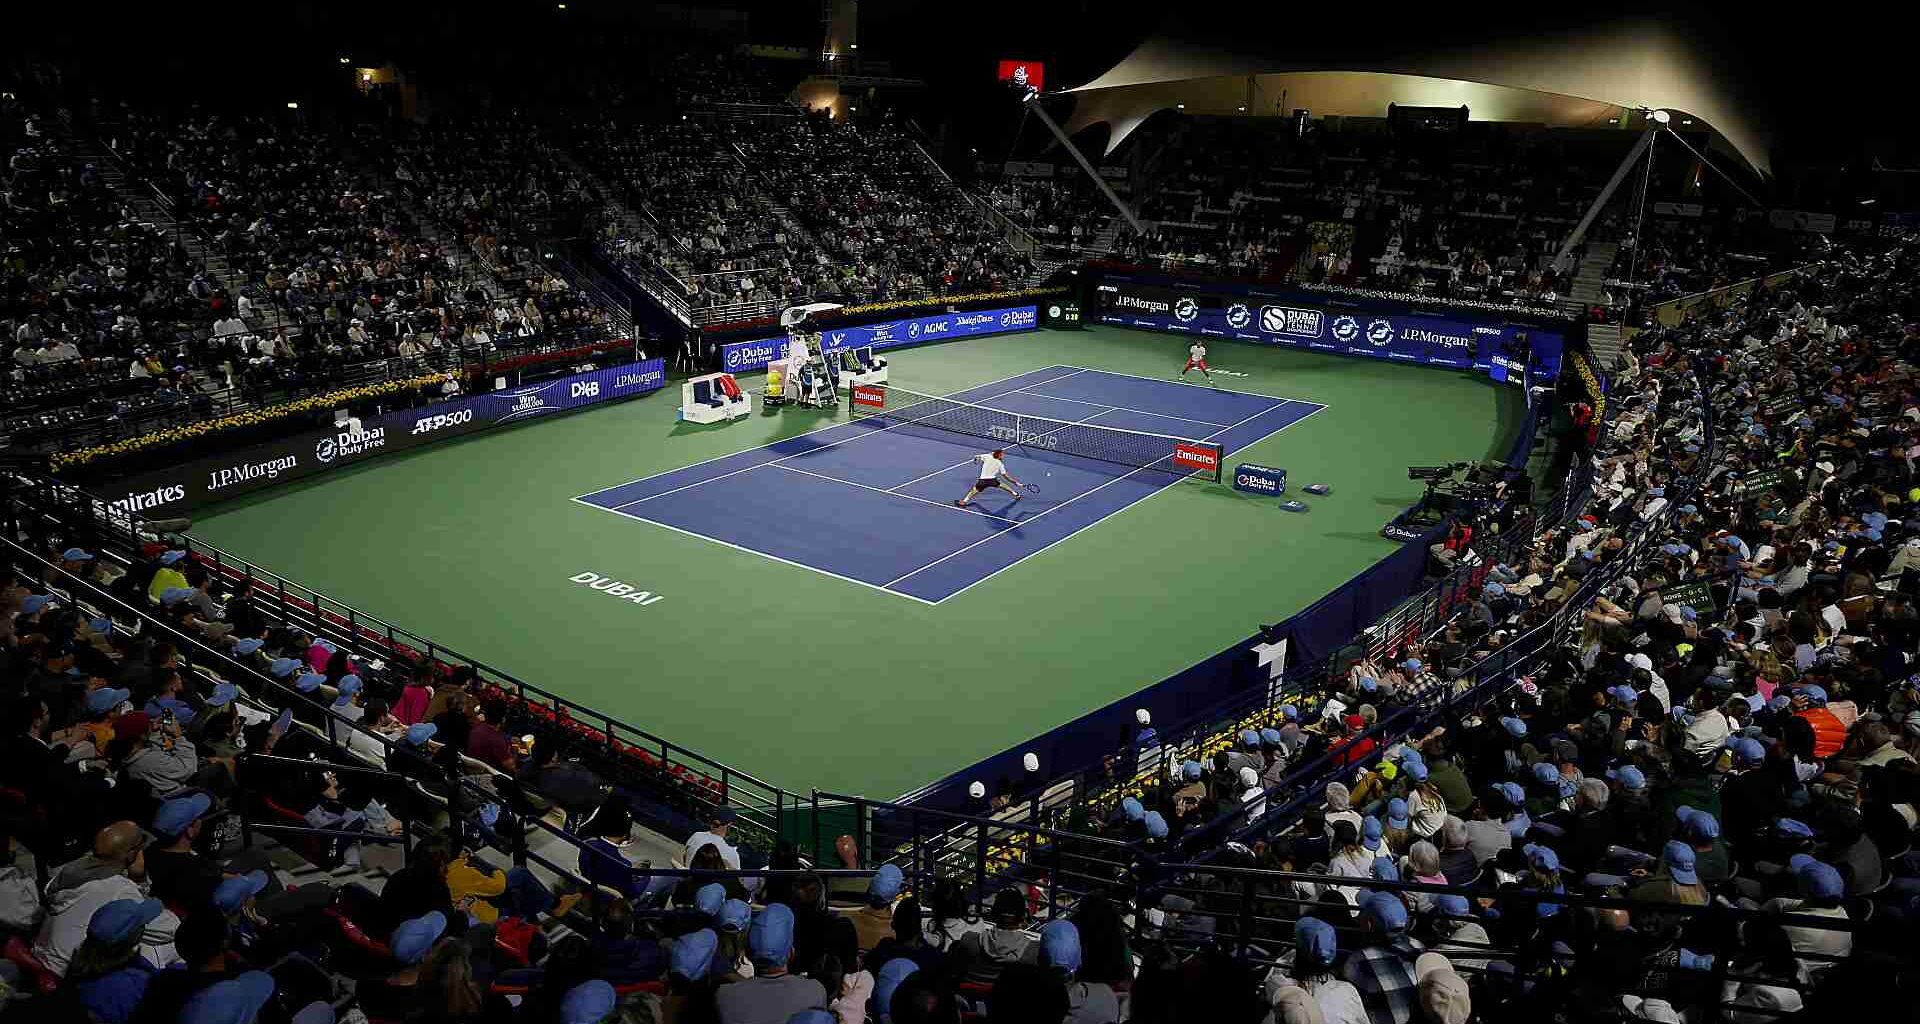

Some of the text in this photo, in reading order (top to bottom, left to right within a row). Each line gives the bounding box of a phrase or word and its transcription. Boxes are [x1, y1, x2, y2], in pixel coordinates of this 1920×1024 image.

[1115, 295, 1169, 313] J.P.Morgan
[1287, 310, 1320, 322] DUBAI
[923, 321, 949, 334] AGMC
[1400, 328, 1469, 349] J.P.Morgan
[742, 346, 772, 357] Dubai
[613, 370, 661, 389] J.P.Morgan
[518, 394, 536, 404] Win
[855, 390, 882, 402] Emirates
[410, 408, 473, 435] ATP500
[338, 427, 385, 446] Dubai
[340, 438, 385, 456] Duty Free
[1176, 449, 1215, 465] Emirates
[207, 454, 297, 490] J.P.Morgan
[1249, 475, 1276, 486] Dubai
[568, 571, 664, 606] DUBAI
